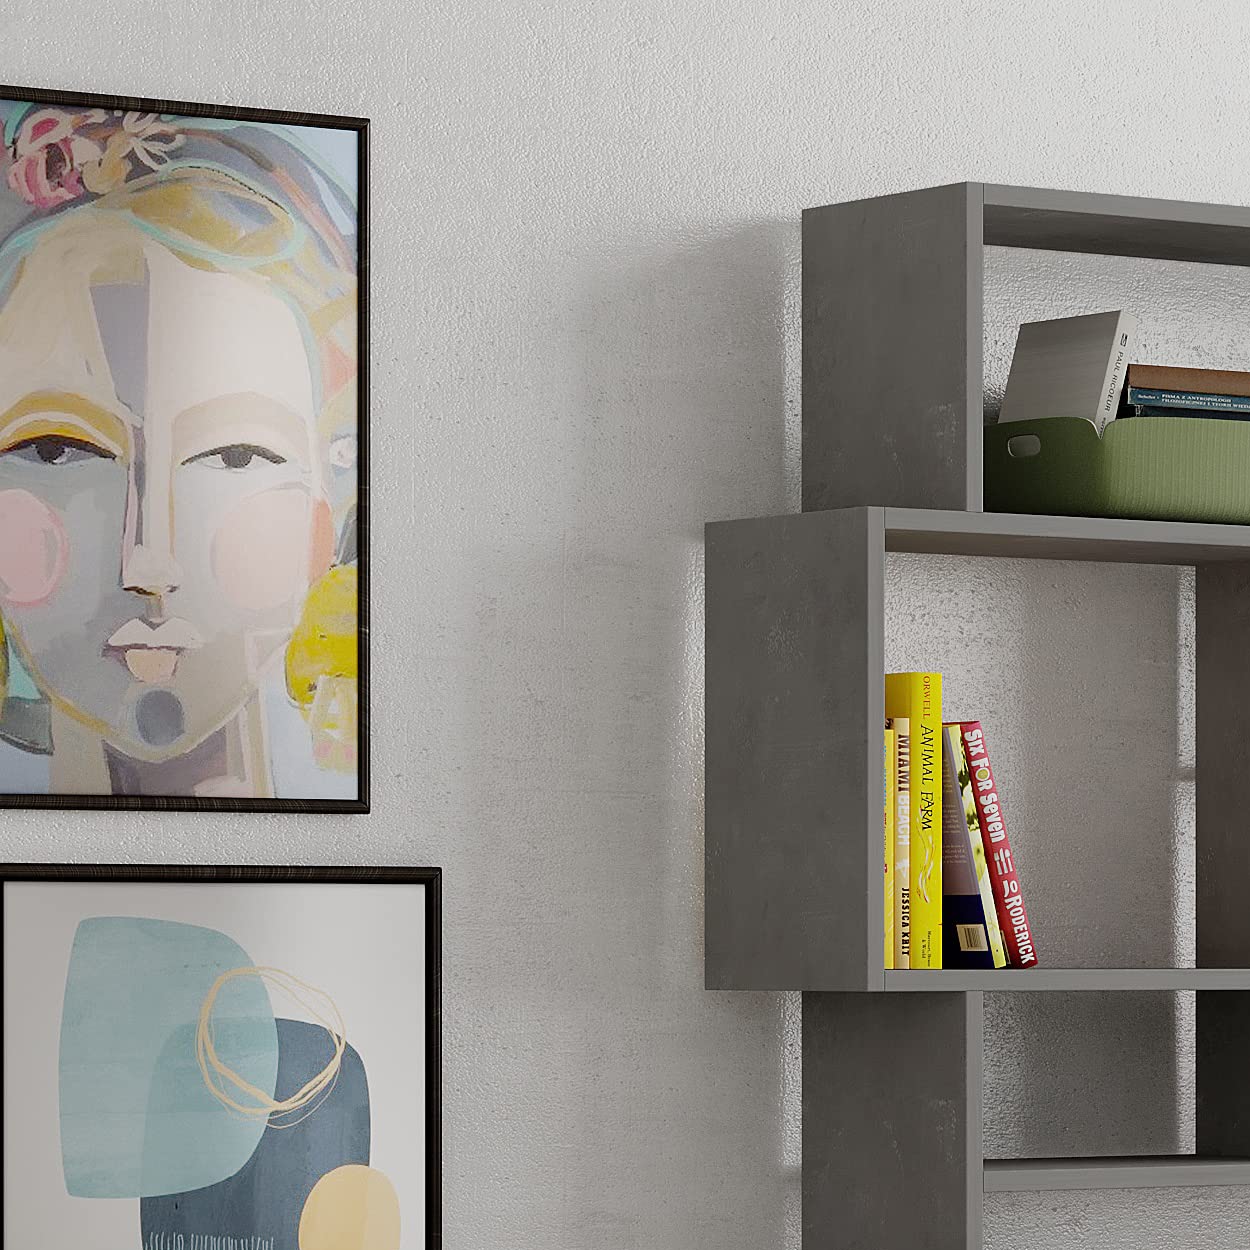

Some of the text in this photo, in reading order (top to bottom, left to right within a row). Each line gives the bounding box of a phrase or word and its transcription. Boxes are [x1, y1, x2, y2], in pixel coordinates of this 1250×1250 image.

[1105, 352, 1123, 412] PAUL RICOEUR
[920, 724, 934, 830] ANIMAL FARM
[964, 729, 984, 756] SIX
[971, 759, 992, 791] FOR
[898, 734, 910, 845] MIAMI BEACH
[1002, 879, 1035, 965] JO RODERICK
